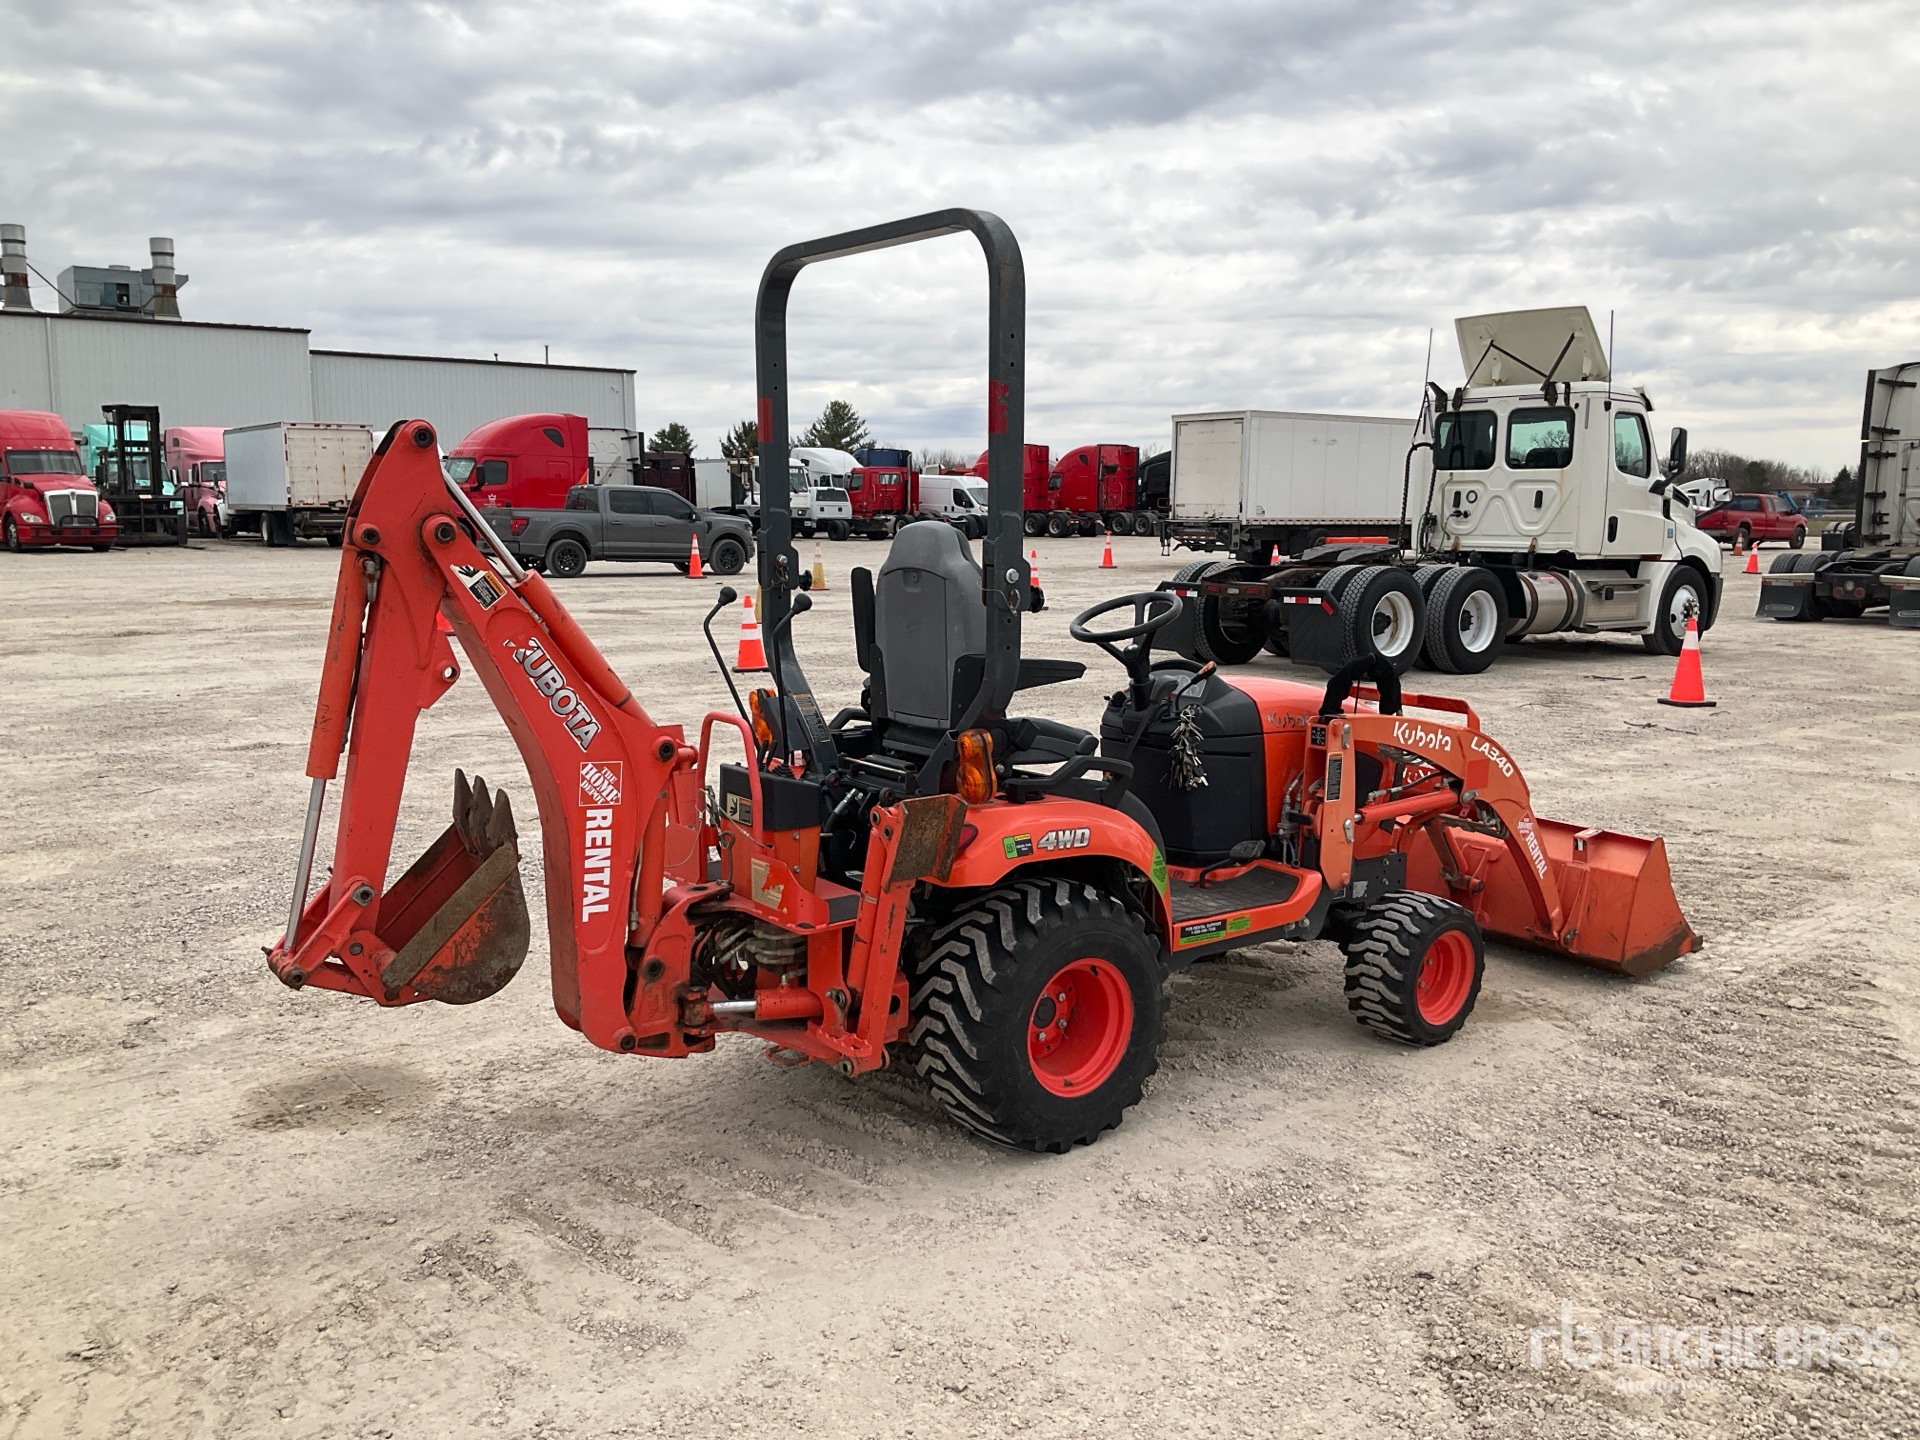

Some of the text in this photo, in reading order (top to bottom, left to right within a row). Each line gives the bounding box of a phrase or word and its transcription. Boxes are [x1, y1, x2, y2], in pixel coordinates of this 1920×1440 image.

[1266, 710, 1309, 729] Kubot
[1393, 721, 1452, 752] Kubota
[1471, 736, 1514, 778] LA340
[581, 762, 621, 804] HOME
[600, 766, 618, 785] THE
[580, 779, 606, 805] DEPOT
[1037, 828, 1091, 851] 4WD
[582, 808, 613, 923] RENTAL
[1525, 831, 1547, 880] RENTAL
